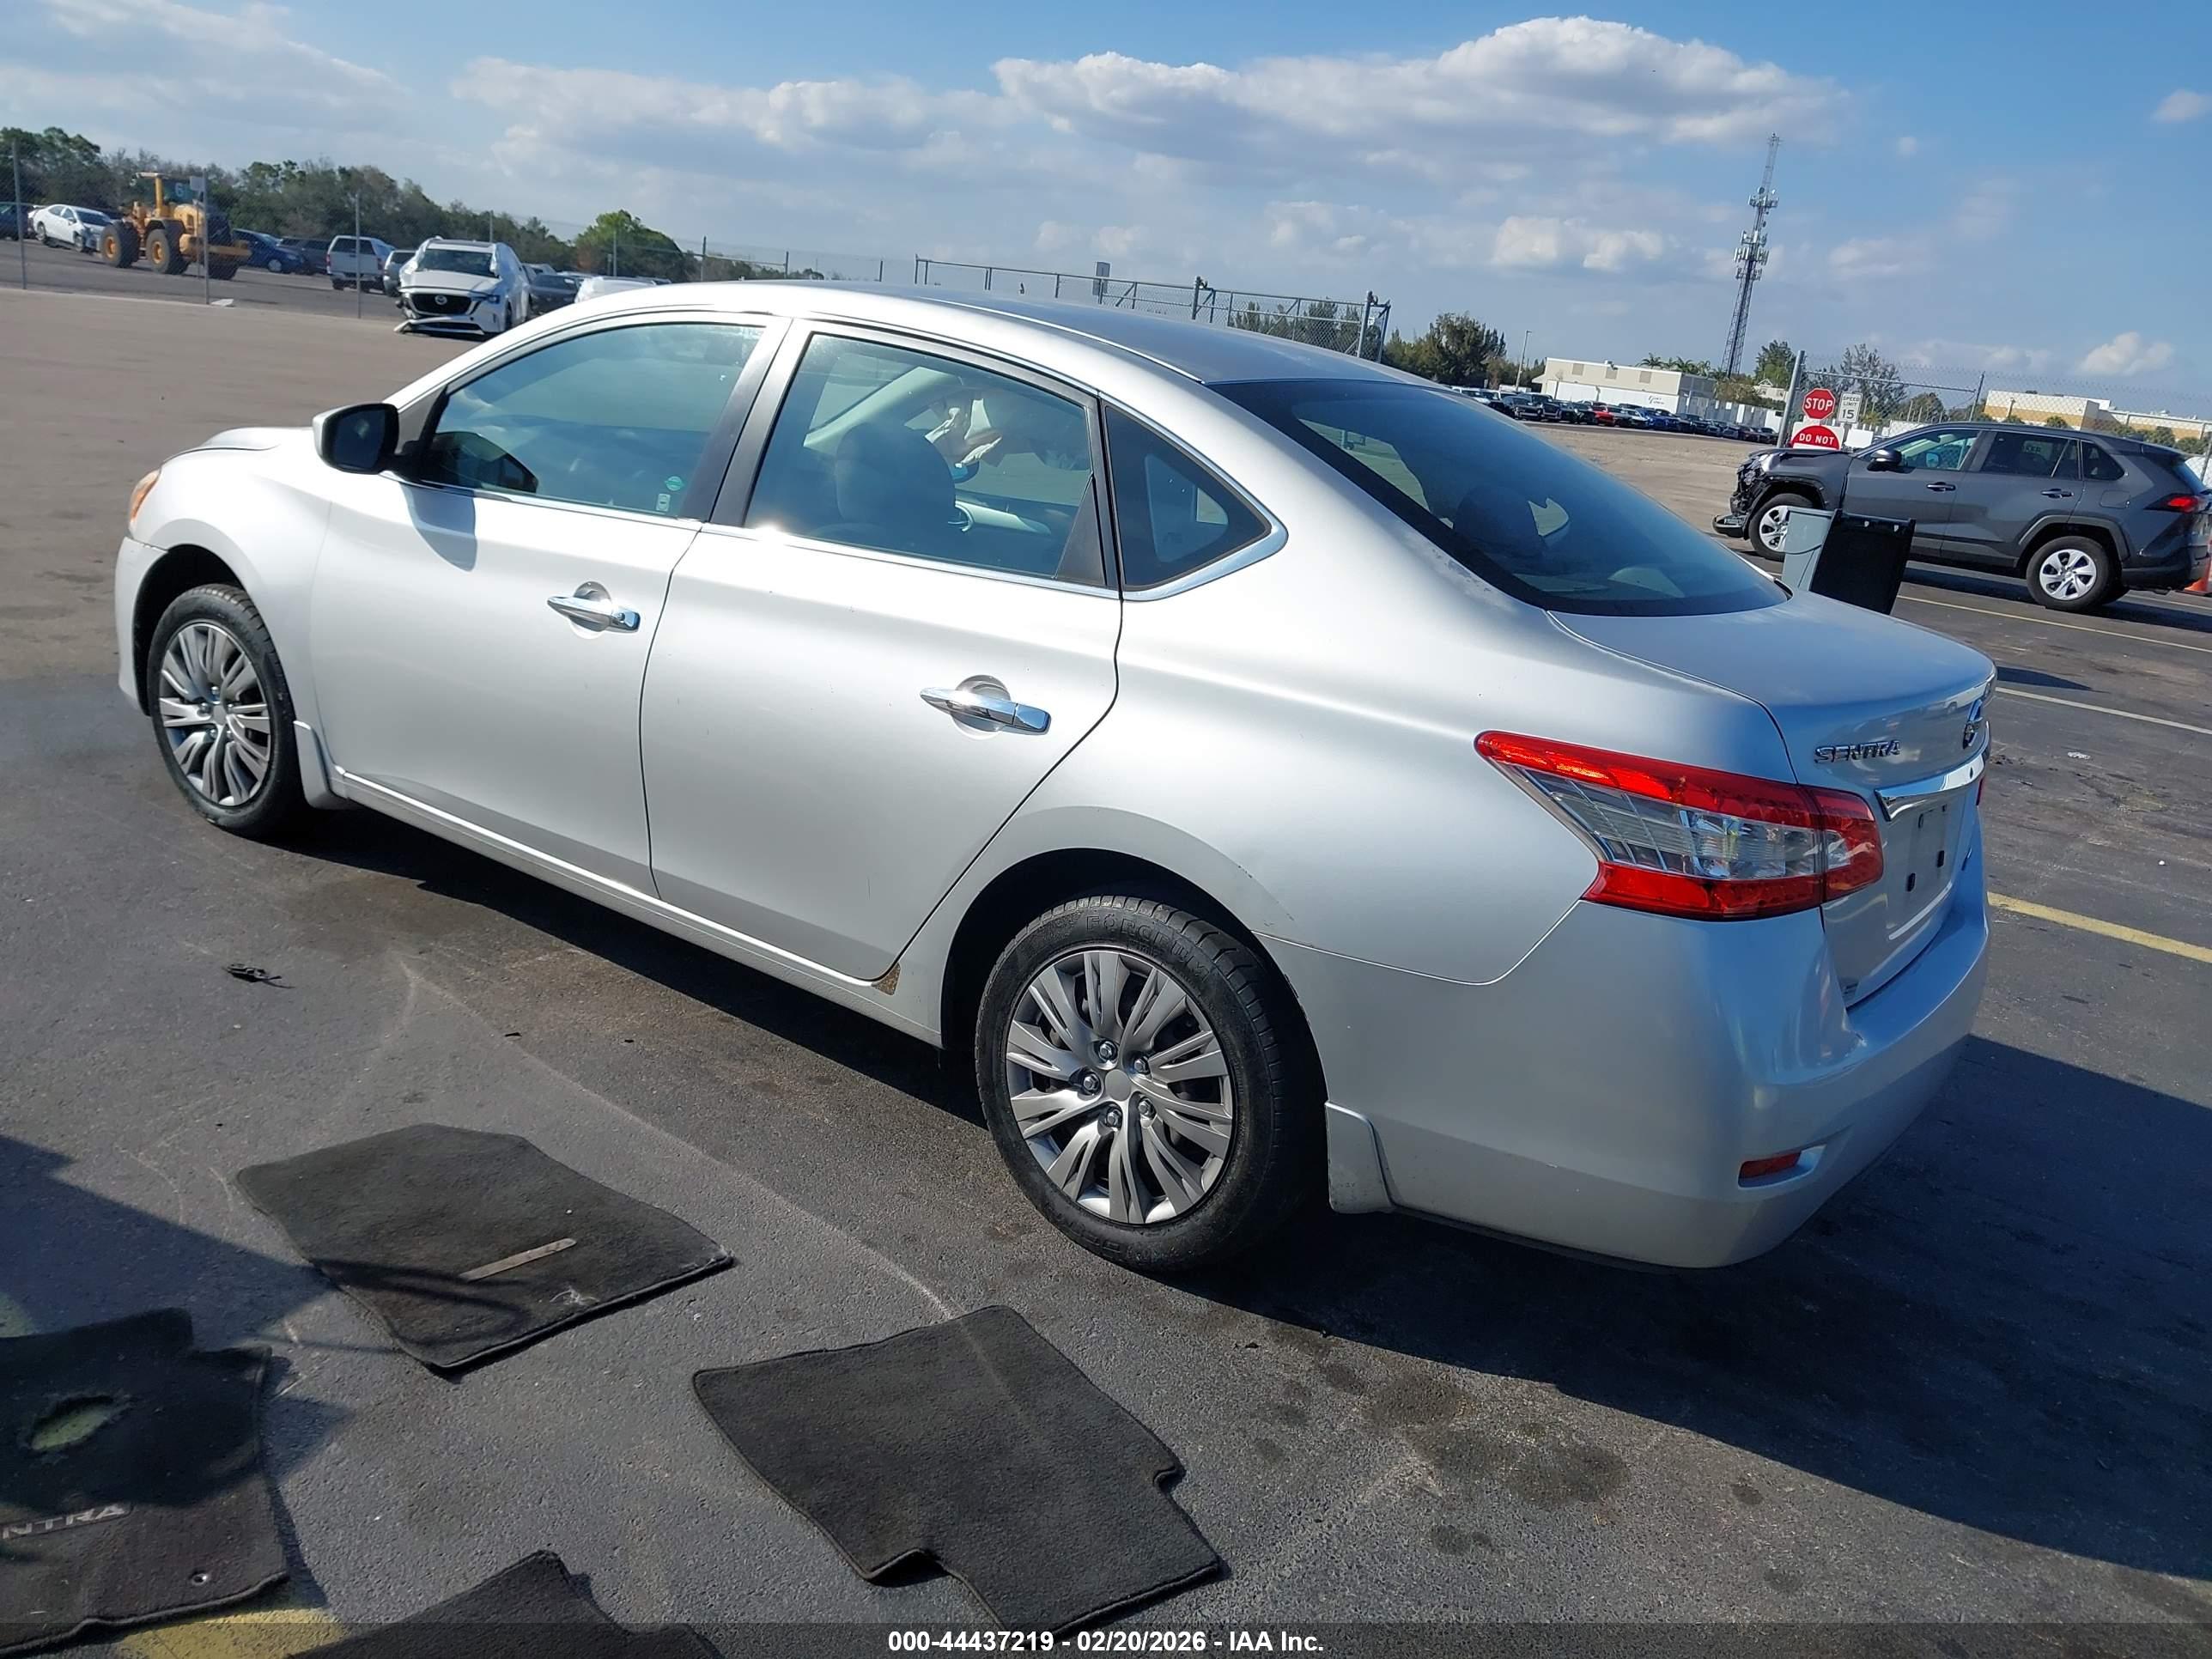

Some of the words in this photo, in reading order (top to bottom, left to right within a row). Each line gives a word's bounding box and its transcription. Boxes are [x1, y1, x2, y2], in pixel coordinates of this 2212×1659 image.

[1804, 398, 1833, 411] STOP
[1842, 409, 1855, 419] 15
[1799, 433, 1812, 442] DO
[1815, 434, 1835, 445] NOT
[1814, 739, 1901, 763] SENTRA
